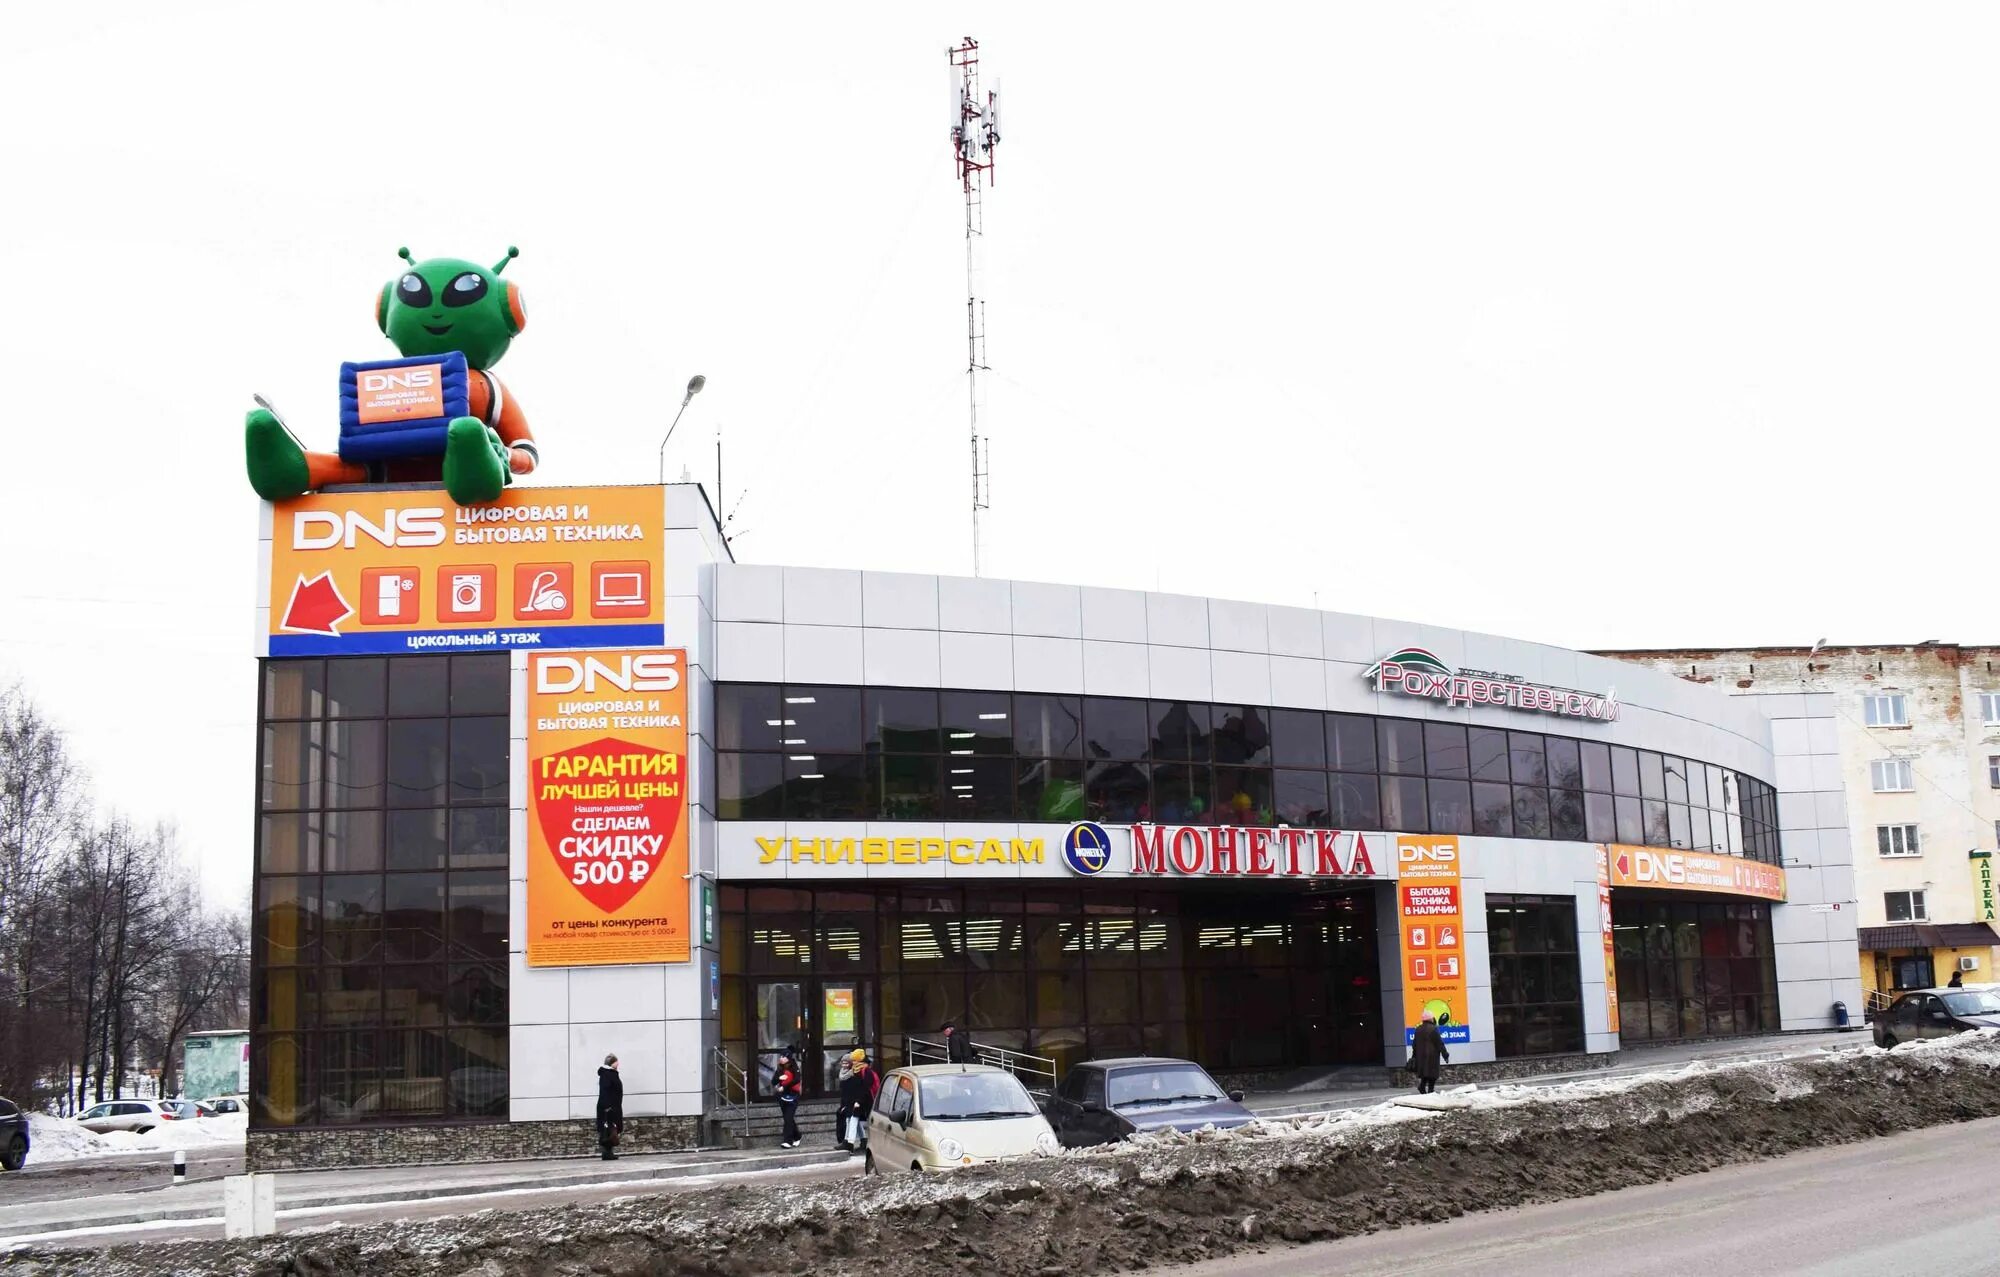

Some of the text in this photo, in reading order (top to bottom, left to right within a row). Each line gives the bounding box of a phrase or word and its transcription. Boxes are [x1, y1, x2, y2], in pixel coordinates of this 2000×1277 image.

[364, 371, 434, 392] DNS
[455, 504, 588, 526] ЦИФРОВАЯ И
[292, 507, 447, 551] DNS
[454, 524, 644, 545] БЫТОВАЯ ТЕХНИКА
[407, 631, 541, 649] цокольный этаж
[537, 654, 680, 695] DNS
[558, 700, 660, 715] ЦИФРОВАЯ И
[537, 715, 681, 731] БЫТОВАЯ ТЕХНИКА
[541, 753, 678, 779] ГАРАНТИЯ
[540, 777, 679, 800] ЛУЧШЕЙ ЦЕНЫ
[574, 803, 644, 813] Нашли дешевле?
[571, 816, 651, 833] СДЕЛАЕМ
[559, 834, 663, 861] СКИДКУ
[754, 837, 1046, 865] УНИВЕРСАМ
[1128, 824, 1377, 876] МОНЕТКА
[1399, 844, 1456, 862] DNS
[571, 861, 624, 885] 500
[1634, 851, 1686, 885] DNS
[1410, 887, 1451, 897] БЫТОВАЯ
[1980, 859, 1995, 920] АПТЕКА
[1404, 905, 1457, 915] В НАЛИЧИИ
[1411, 896, 1451, 906] ТЕХНИКА
[552, 916, 668, 931] от цены конкурента
